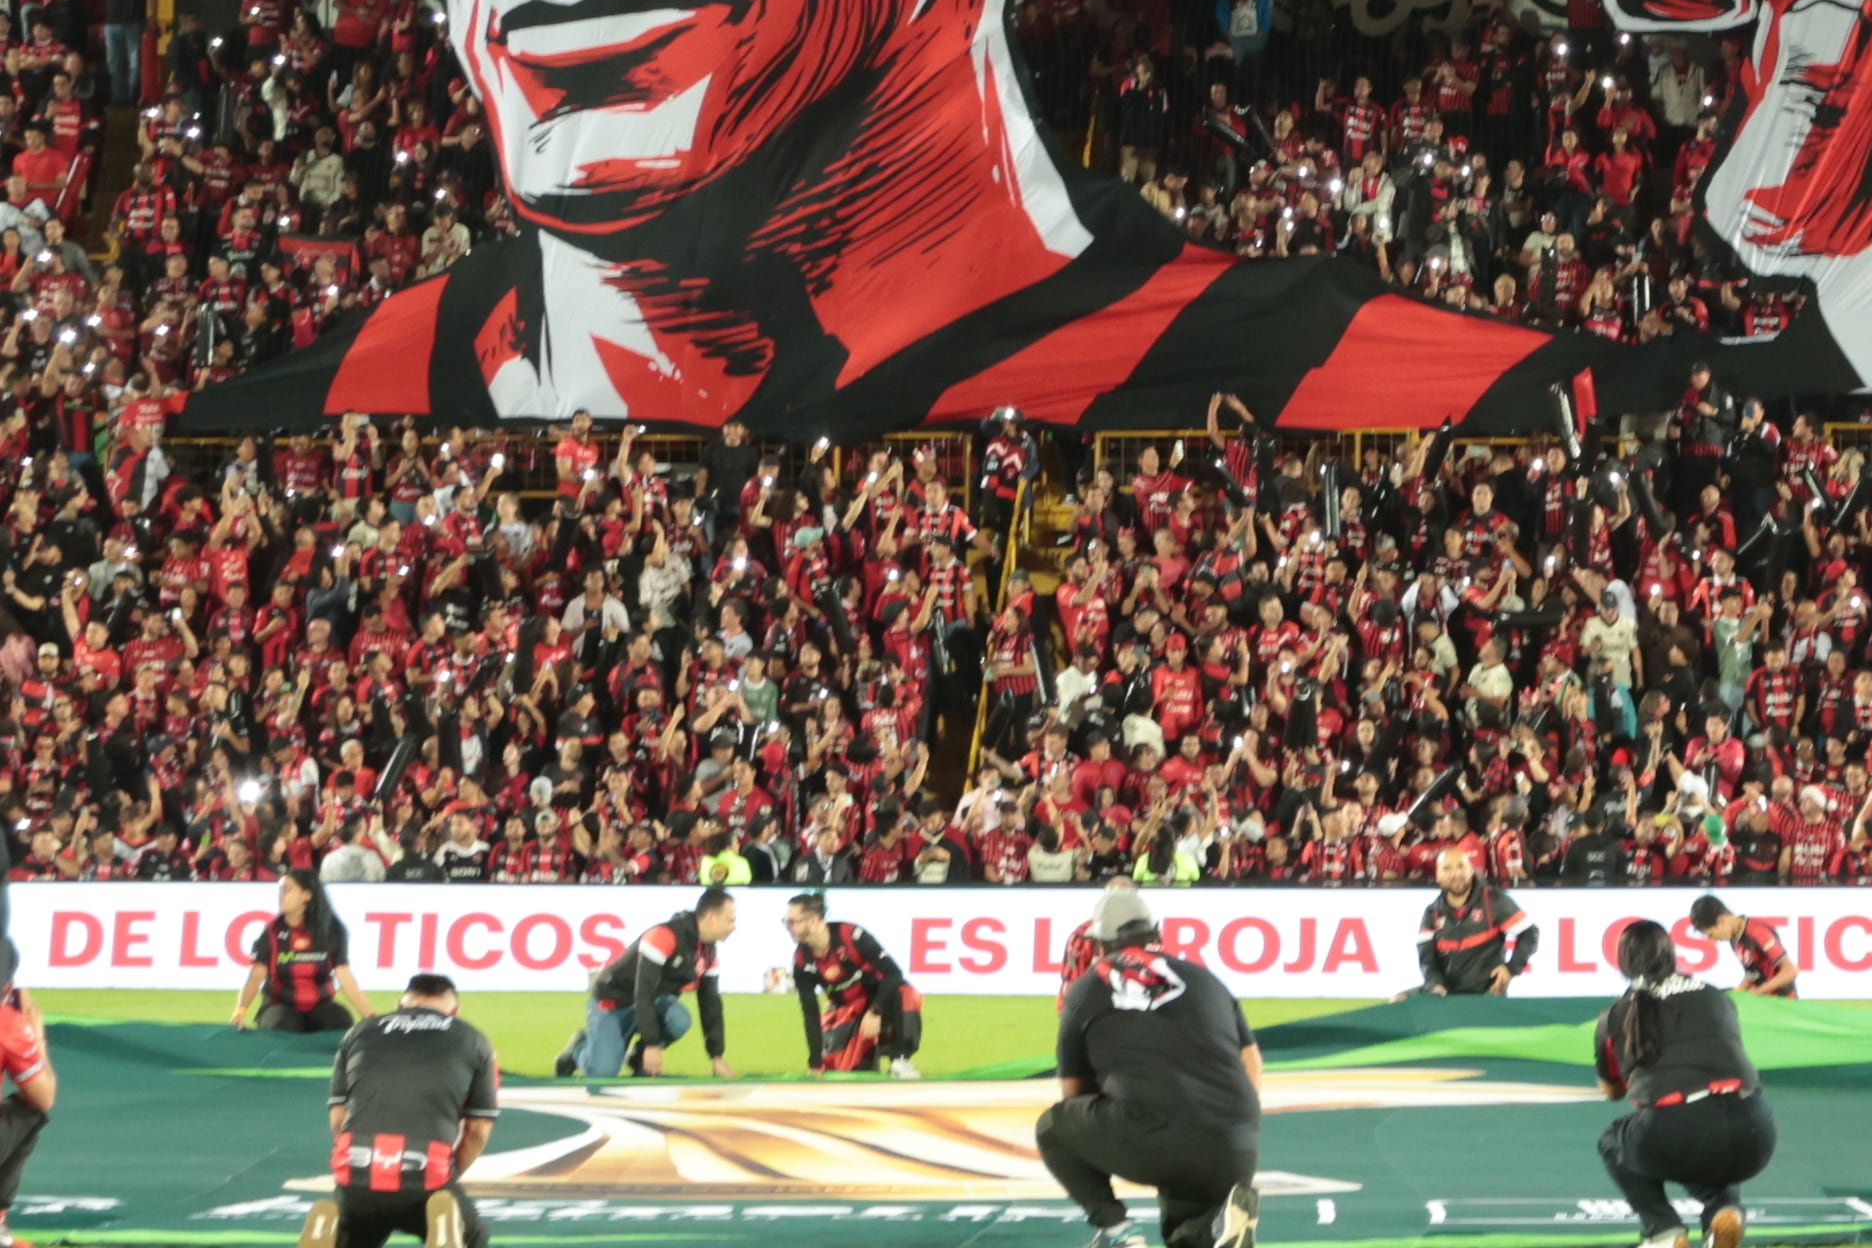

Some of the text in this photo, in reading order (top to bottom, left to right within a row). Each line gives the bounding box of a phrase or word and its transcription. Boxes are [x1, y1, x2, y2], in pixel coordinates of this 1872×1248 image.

[48, 910, 628, 971] DE LO TICOS
[909, 916, 1008, 975] ES
